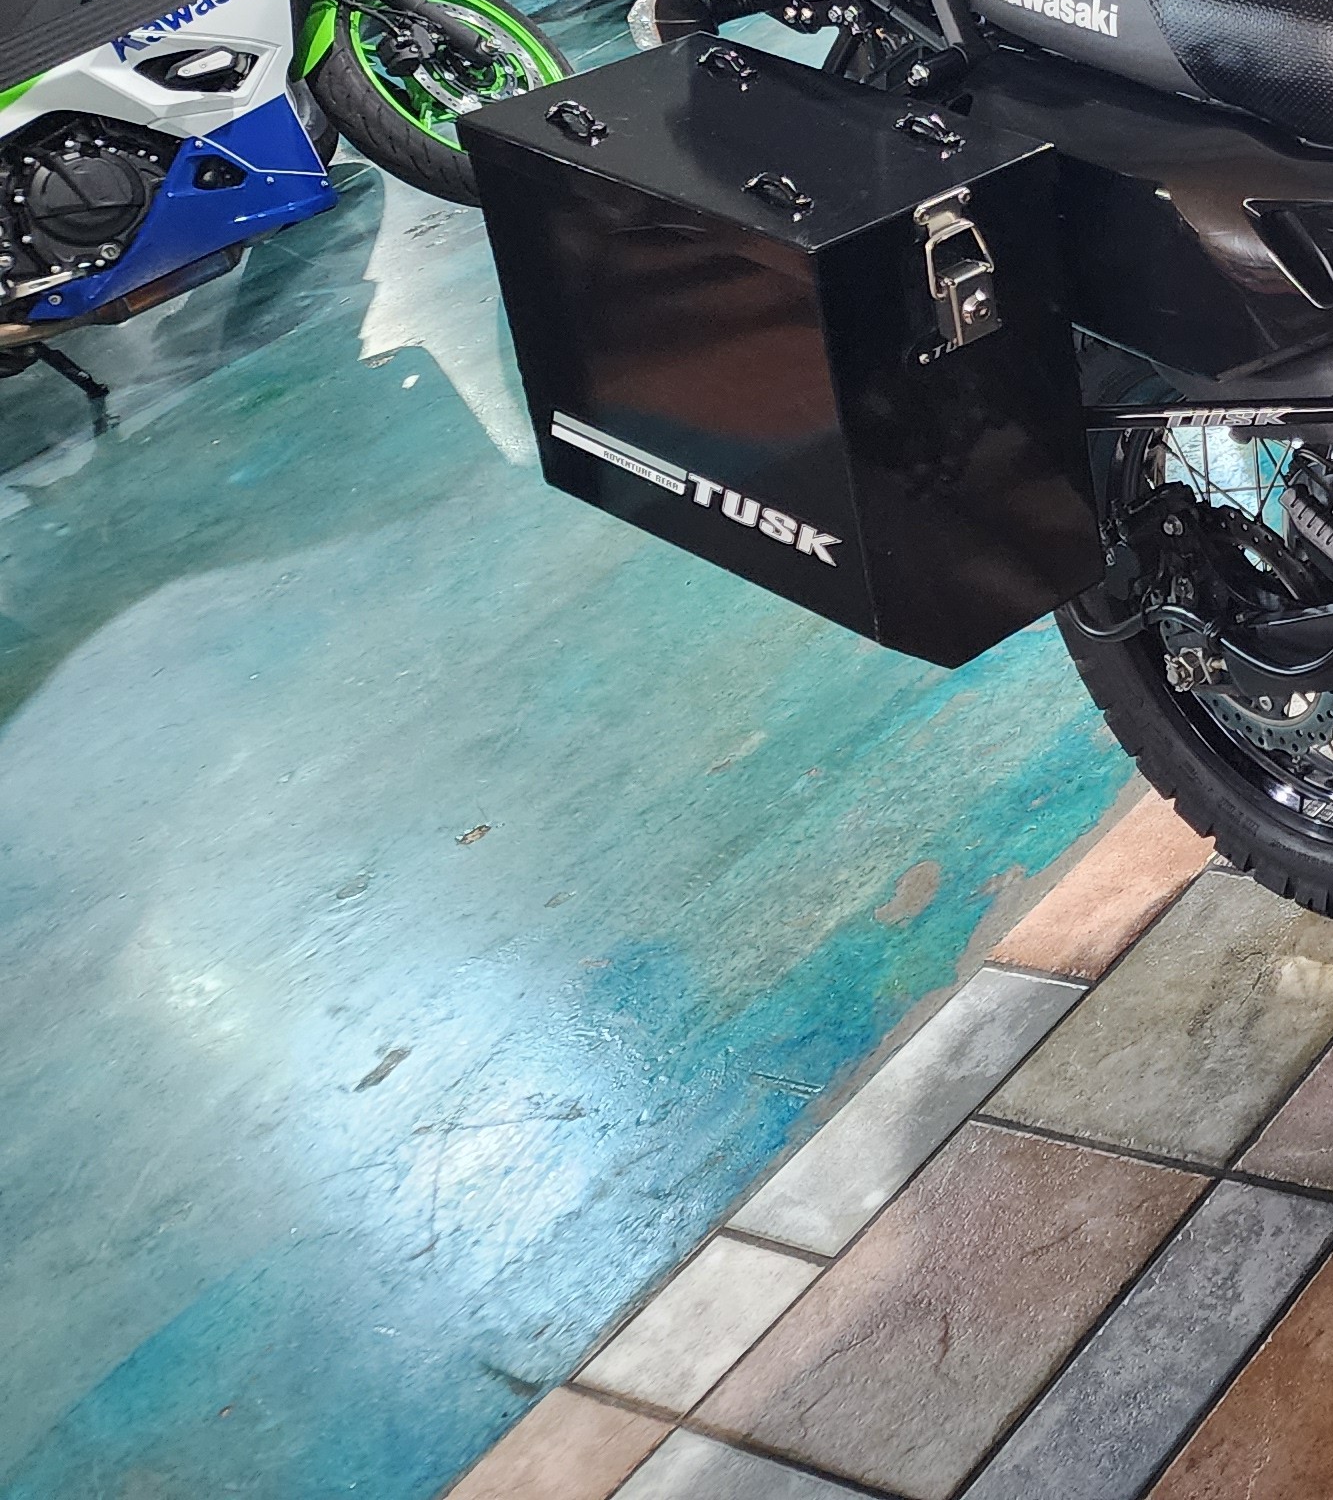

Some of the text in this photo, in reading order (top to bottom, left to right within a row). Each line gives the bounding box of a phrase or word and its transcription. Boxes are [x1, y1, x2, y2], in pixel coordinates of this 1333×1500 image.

[1164, 407, 1294, 428] TUSK
[603, 451, 653, 478] ADVENTURE
[688, 472, 843, 567] TUSK
